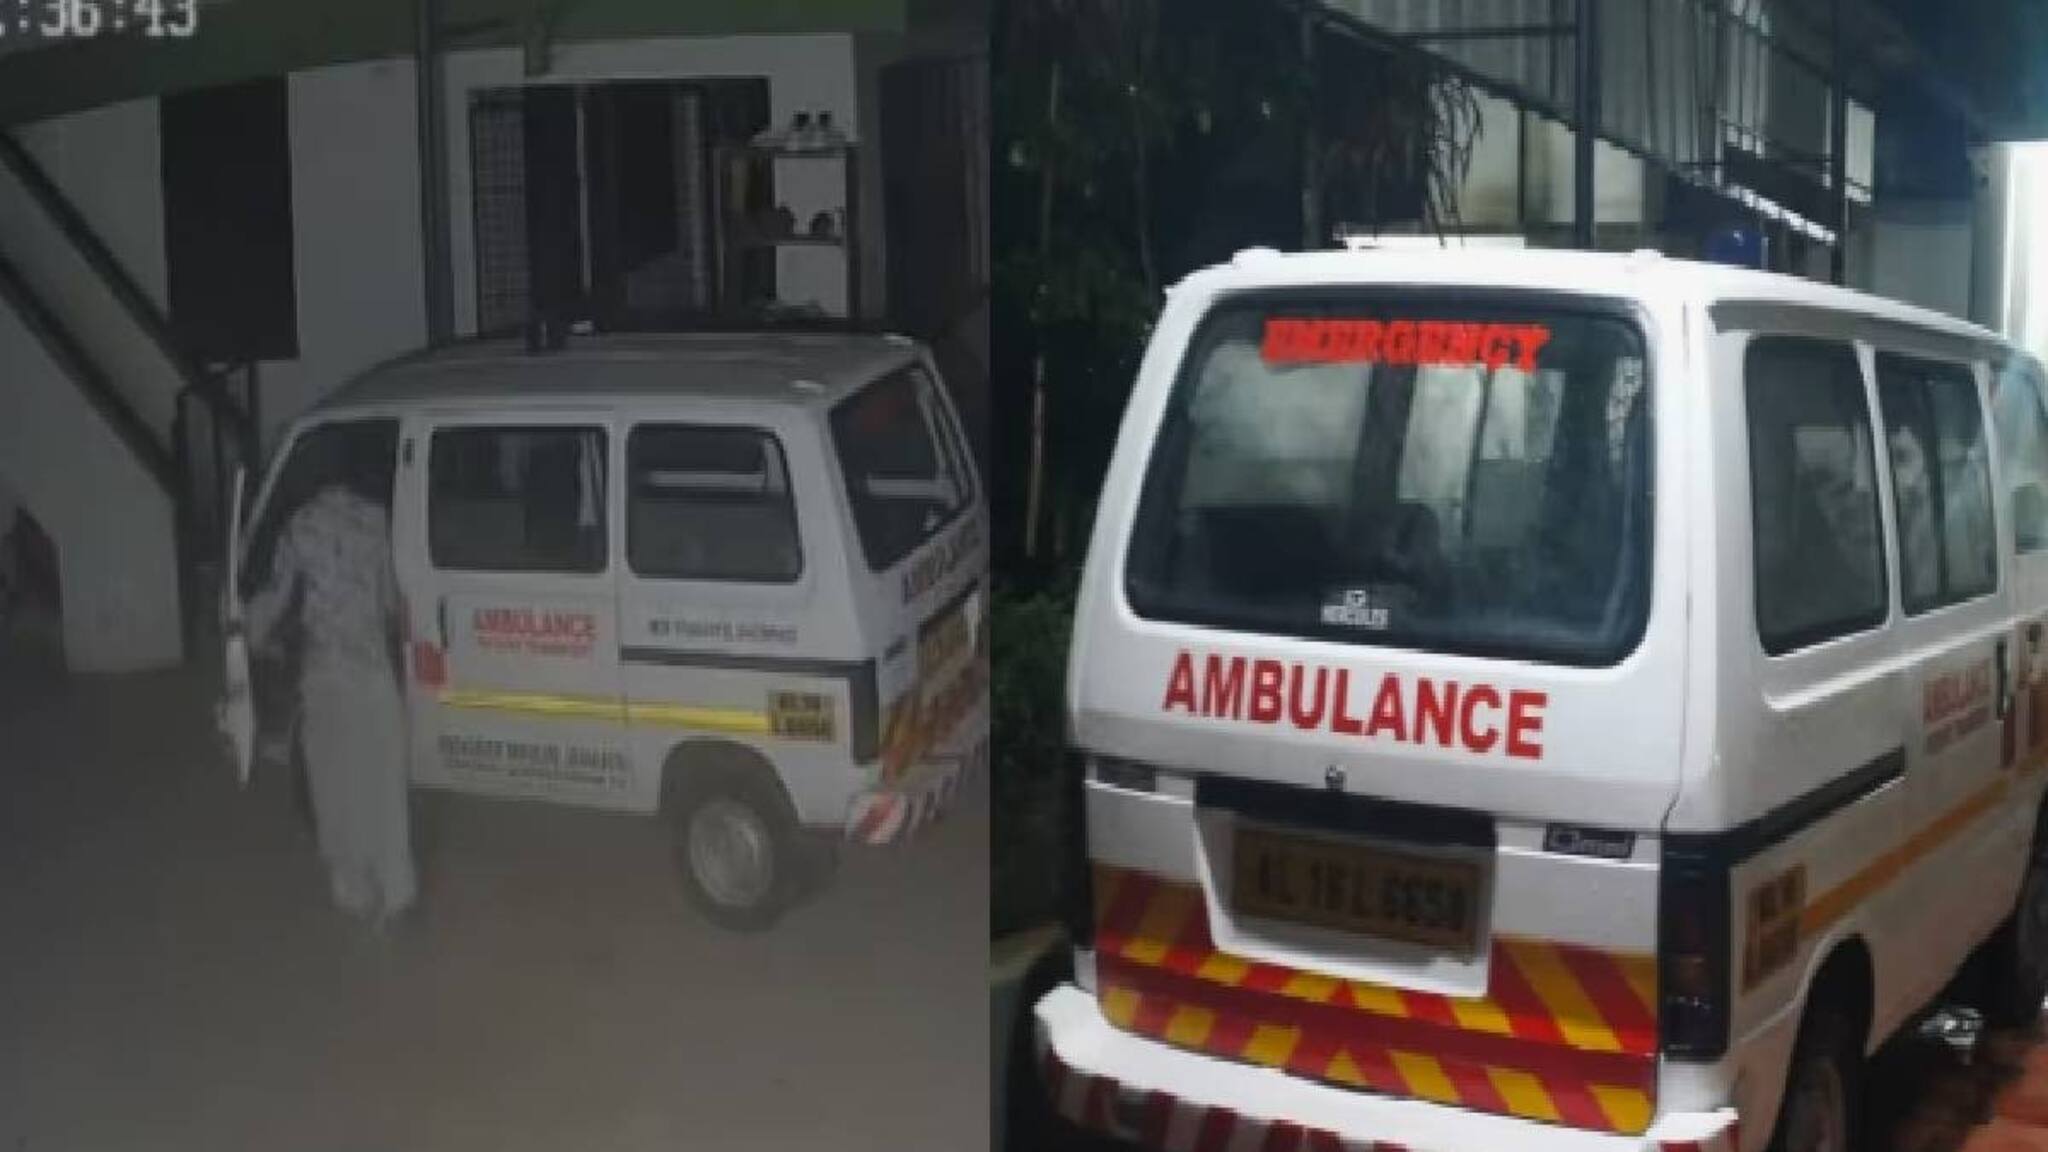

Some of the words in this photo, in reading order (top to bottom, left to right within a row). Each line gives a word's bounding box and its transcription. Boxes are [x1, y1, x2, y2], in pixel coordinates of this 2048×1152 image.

[1259, 316, 1551, 376] EMERGENCY
[472, 608, 597, 641] AMBULANCE
[1162, 648, 1549, 760] AMBULANCE
